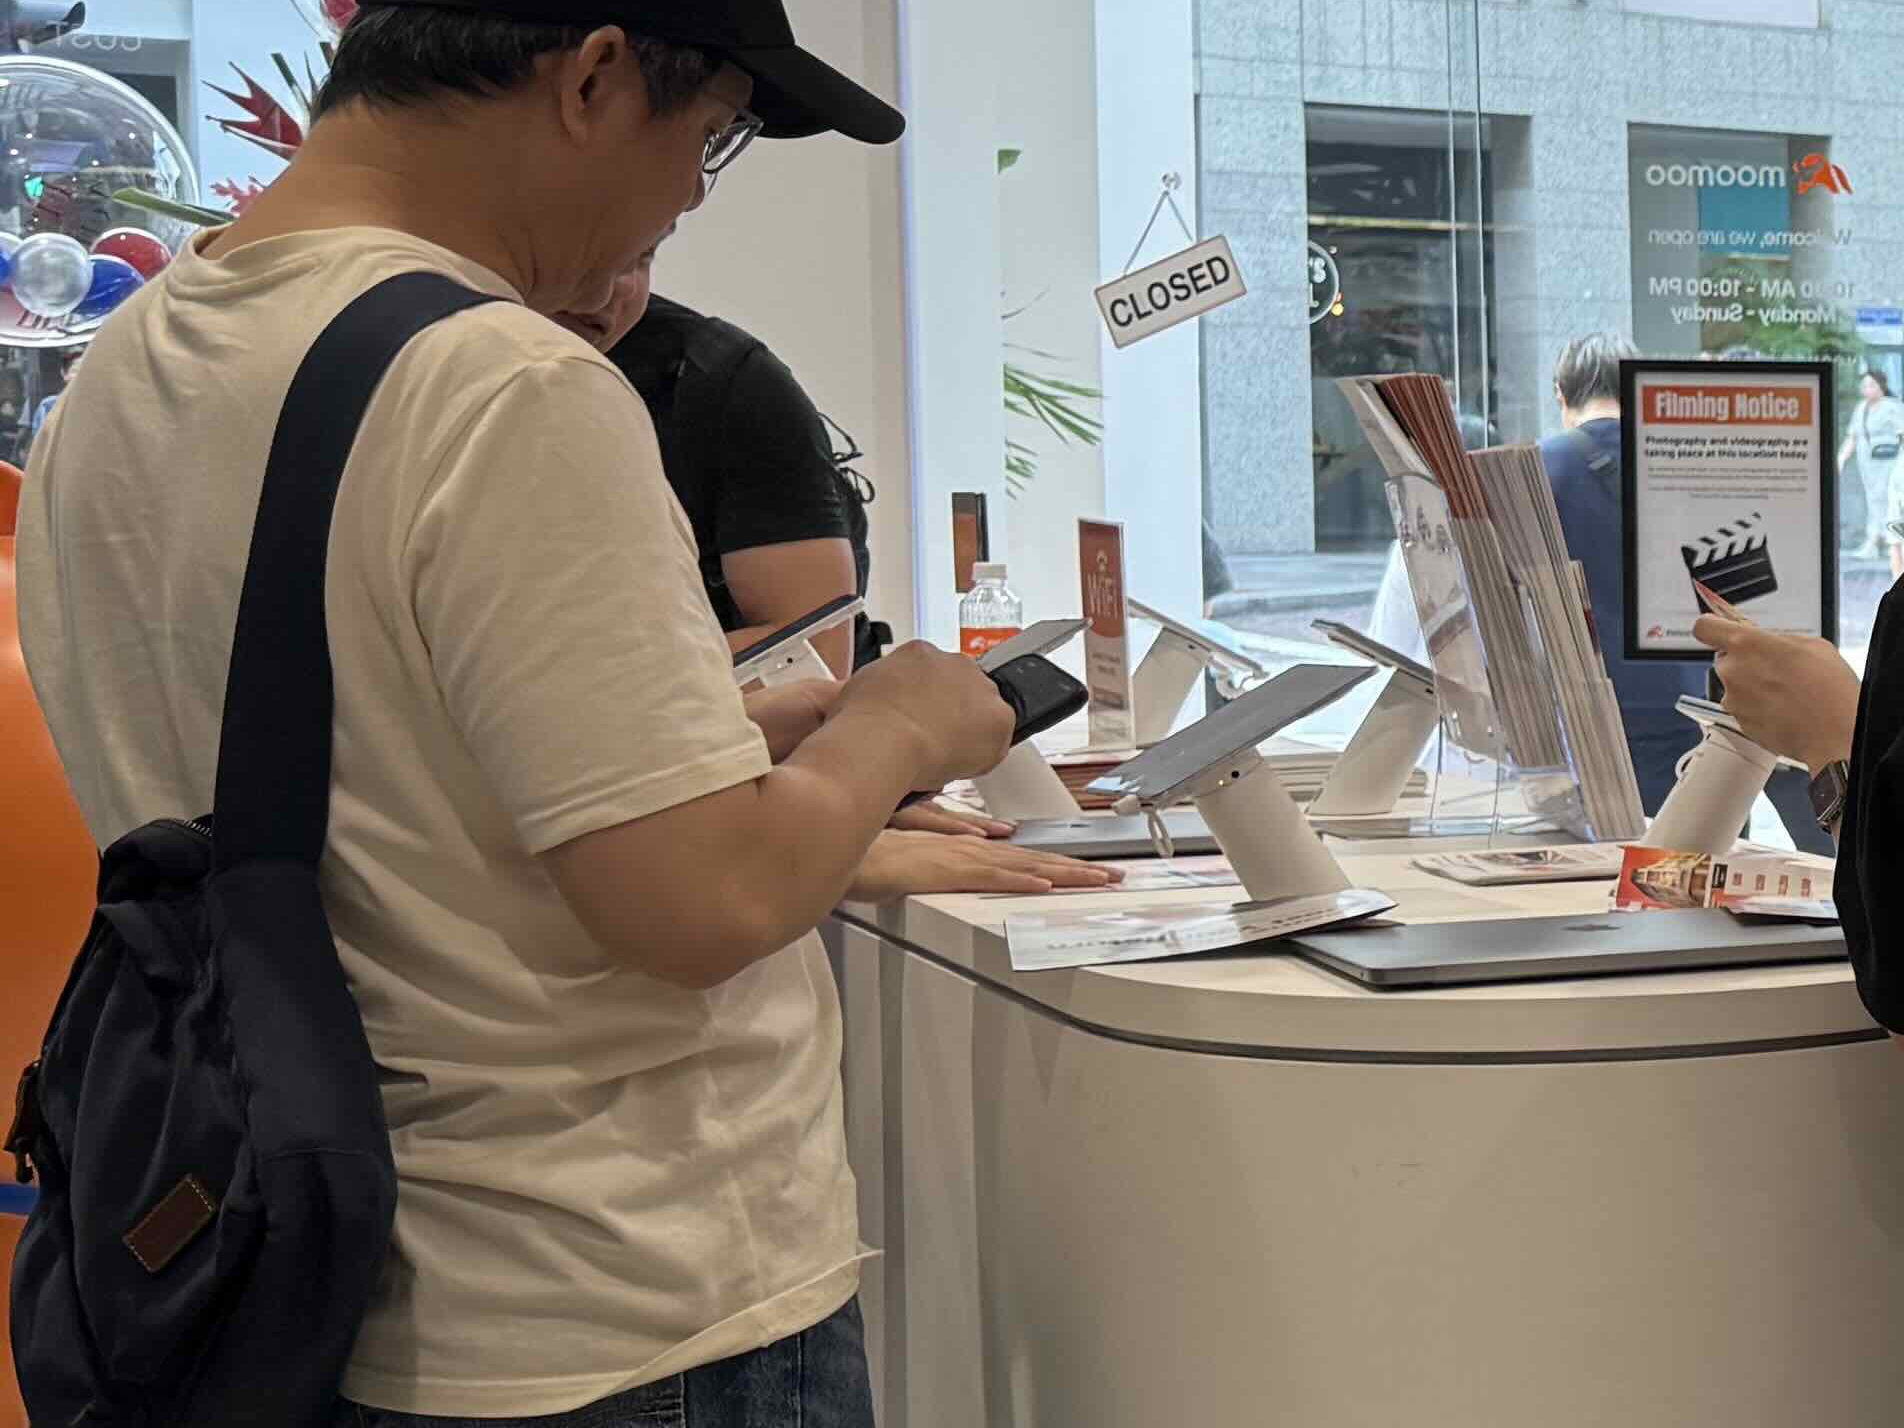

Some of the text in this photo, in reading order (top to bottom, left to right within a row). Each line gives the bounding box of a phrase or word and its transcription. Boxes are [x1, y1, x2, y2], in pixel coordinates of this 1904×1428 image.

[1110, 256, 1231, 328] CLOSED
[1656, 391, 1799, 421] Filming Notice
[1646, 436, 1808, 447] Photography and videography are
[1645, 449, 1675, 460] taking
[1678, 449, 1702, 460] place
[1706, 450, 1716, 458] at
[1718, 449, 1736, 458] this
[1739, 449, 1777, 459] location
